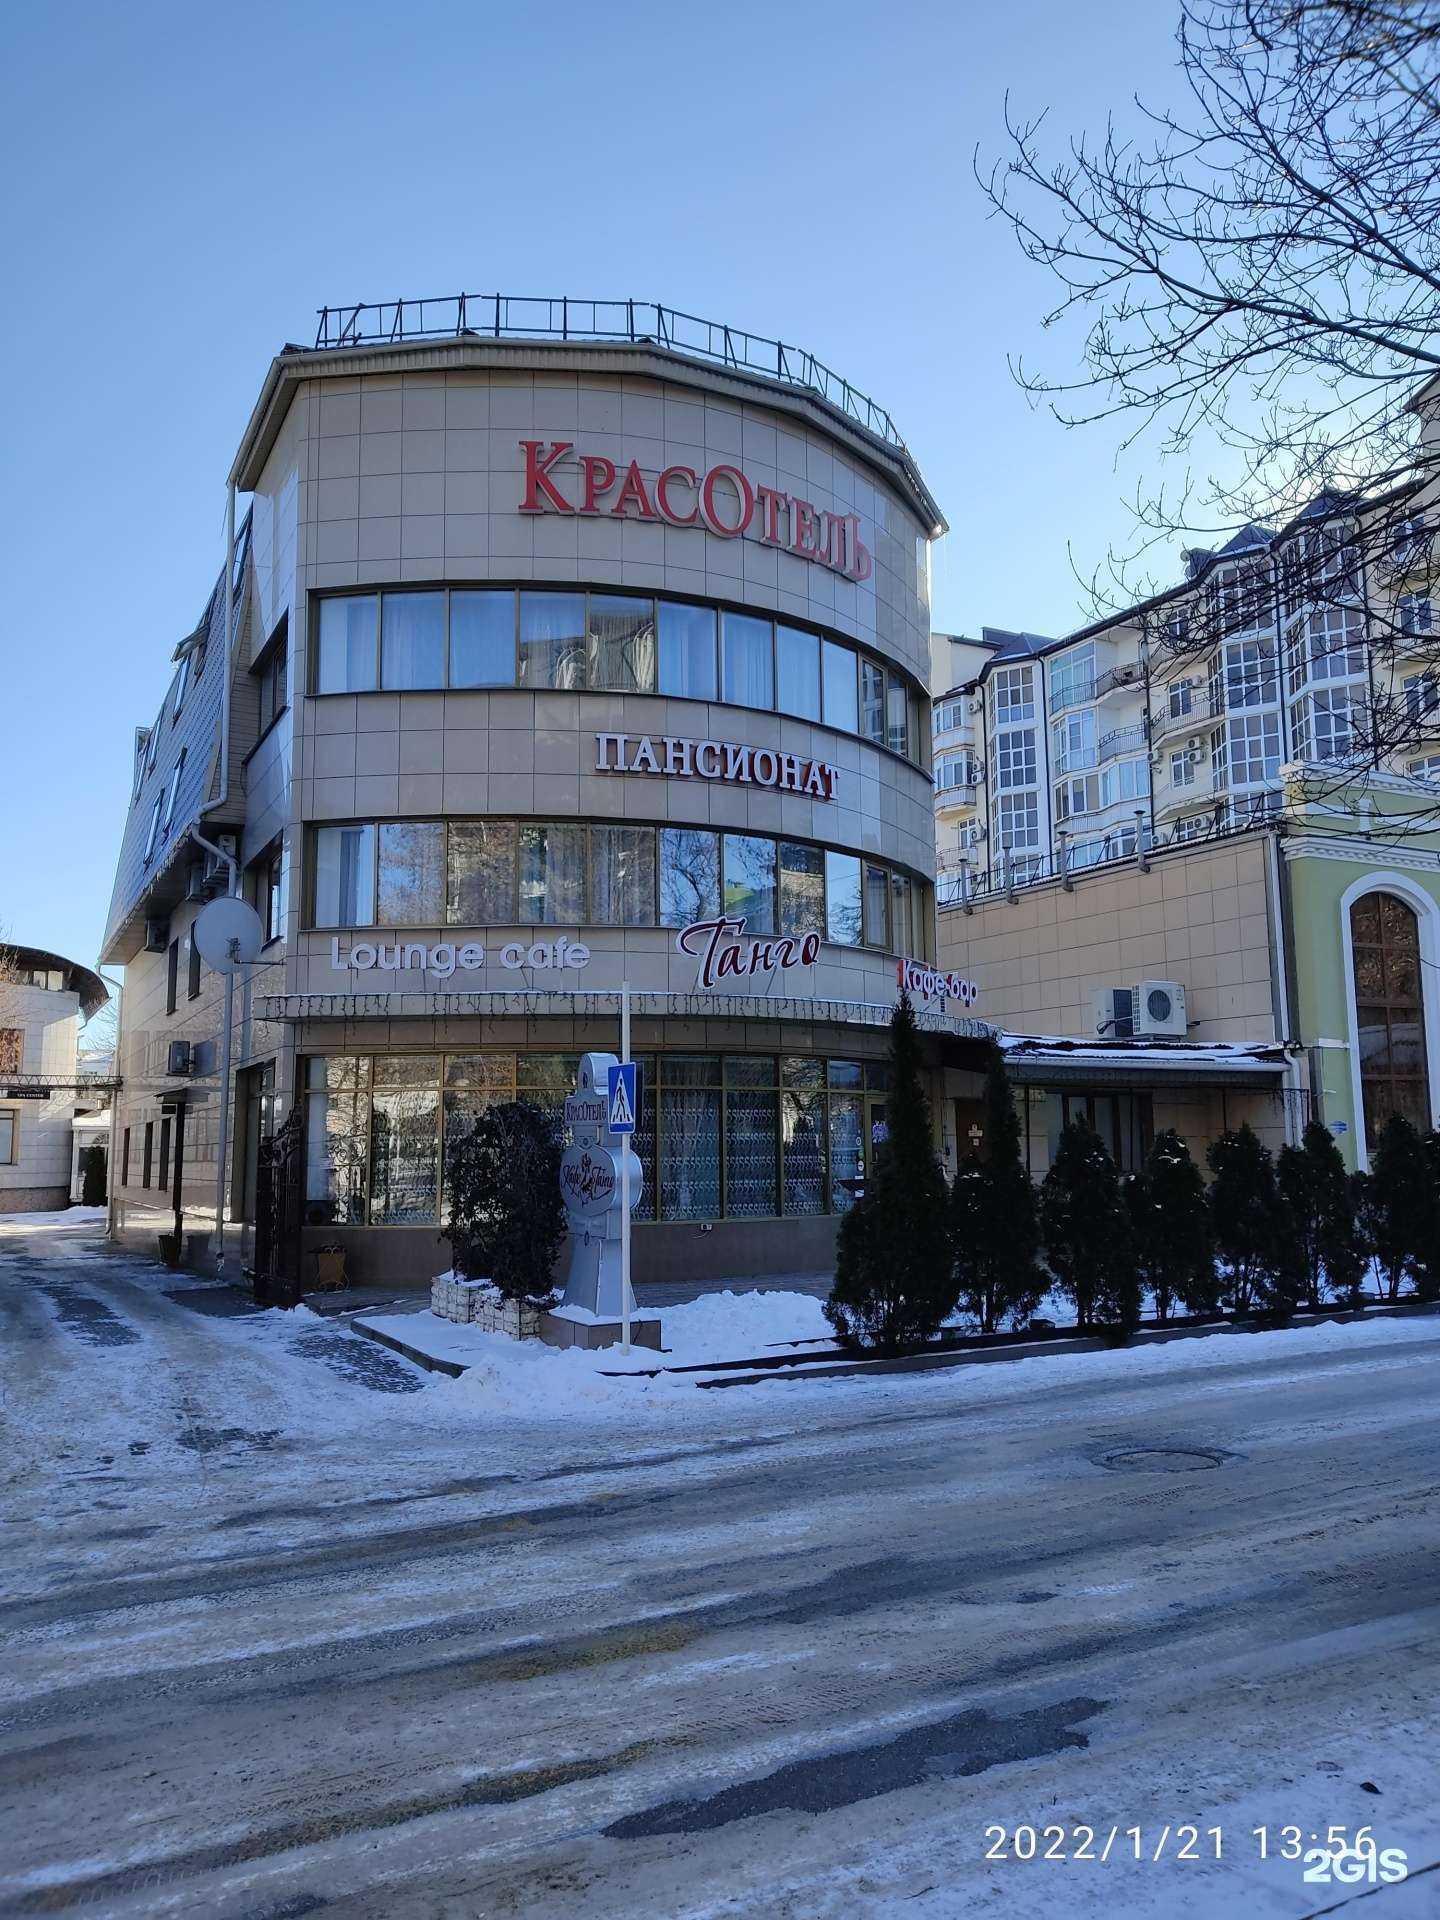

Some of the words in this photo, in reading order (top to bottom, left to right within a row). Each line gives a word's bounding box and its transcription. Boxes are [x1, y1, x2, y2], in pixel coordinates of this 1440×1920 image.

[595, 733, 840, 801] ПАНСИОНАТ
[331, 936, 484, 979] Lounge
[500, 935, 591, 970] cafe
[676, 916, 821, 989] Танго
[896, 959, 978, 1008] Кафе-бар
